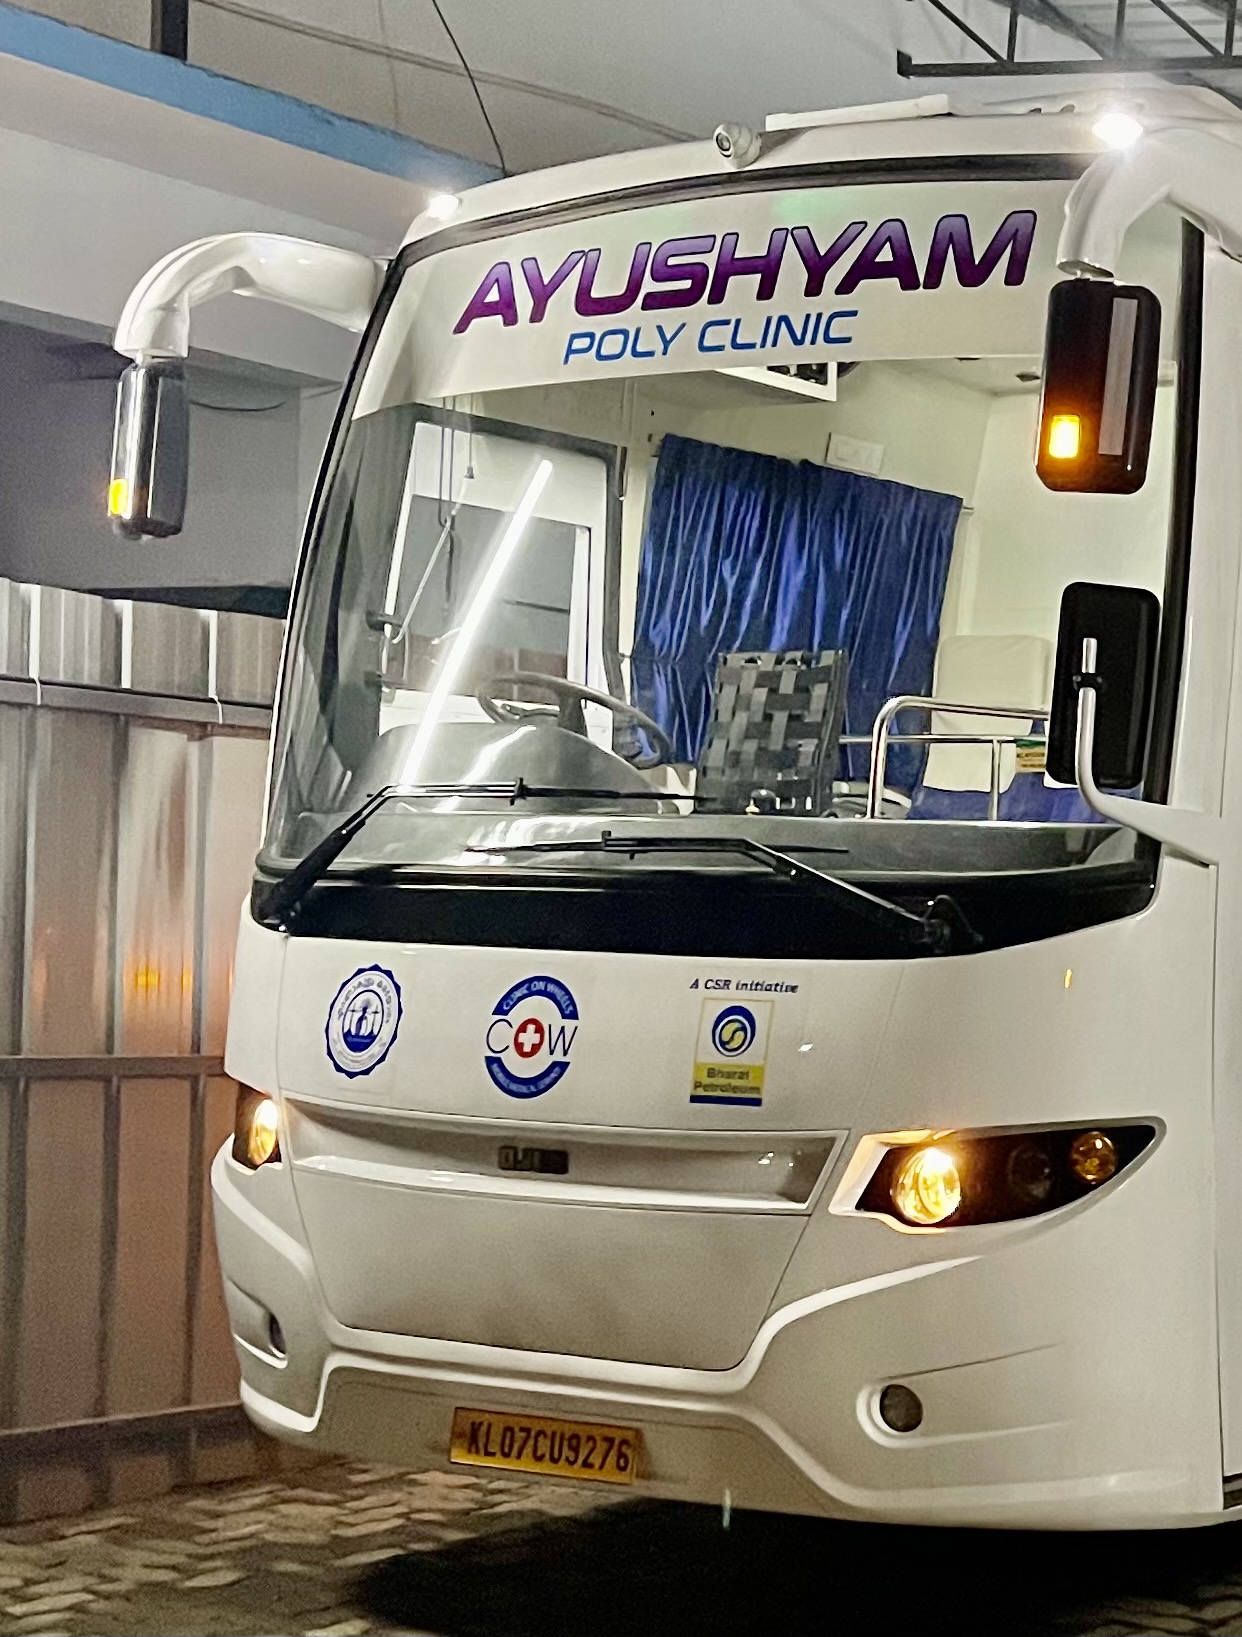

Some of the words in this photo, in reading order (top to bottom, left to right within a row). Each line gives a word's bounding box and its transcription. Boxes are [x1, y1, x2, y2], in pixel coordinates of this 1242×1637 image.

[453, 209, 1038, 336] AYUSHYAM
[563, 322, 686, 366] POLY
[697, 309, 859, 354] CLINIC
[530, 980, 546, 992] ON
[689, 978, 700, 990] A
[704, 978, 732, 991] CSR
[735, 980, 800, 994] initiative
[707, 1067, 750, 1080] Bharat
[693, 1080, 761, 1096] Petroleum
[466, 1420, 633, 1473] KL07CU9276
